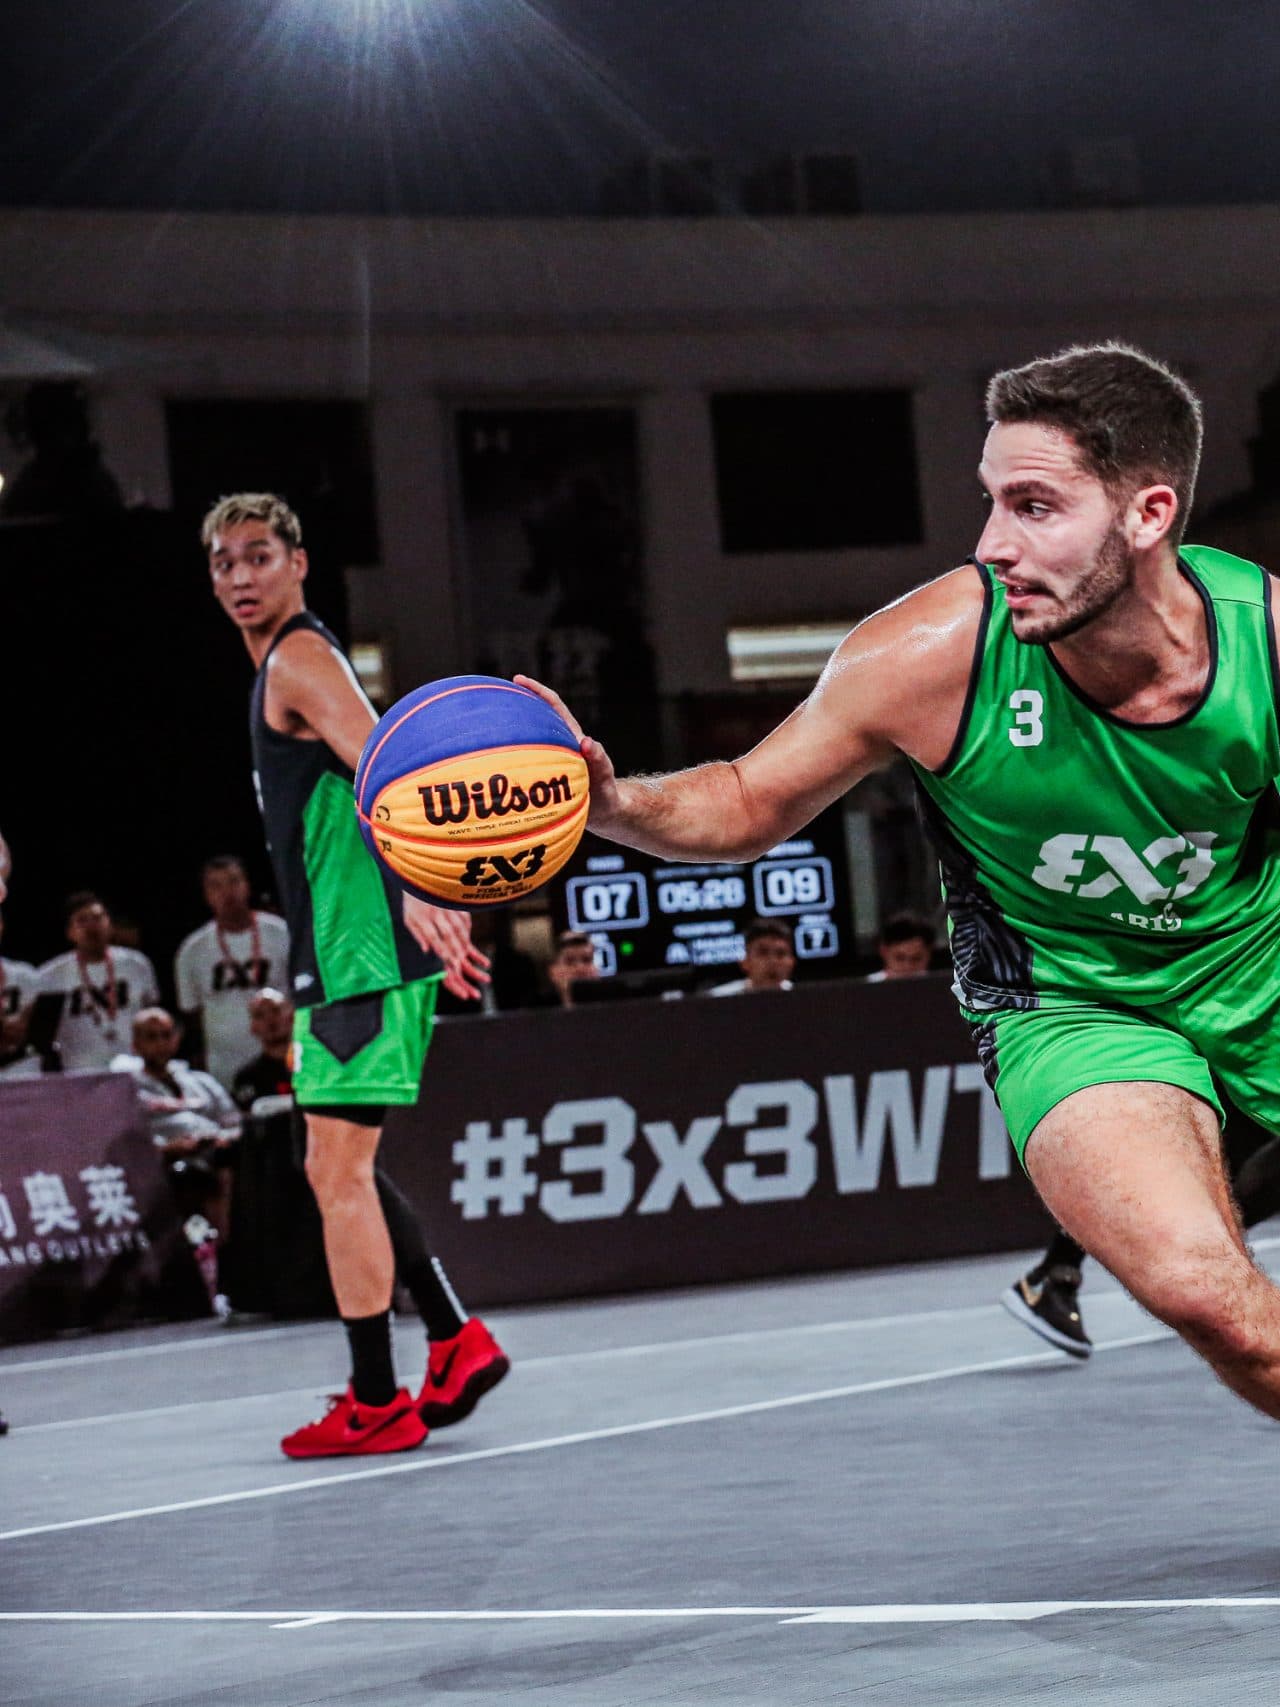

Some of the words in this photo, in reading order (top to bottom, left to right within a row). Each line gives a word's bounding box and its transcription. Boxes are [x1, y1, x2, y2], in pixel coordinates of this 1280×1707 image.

[1008, 689, 1045, 747] 3
[418, 773, 574, 827] Wilson
[447, 827, 472, 836] WAVE
[582, 882, 633, 921] 07
[766, 867, 821, 905] 09
